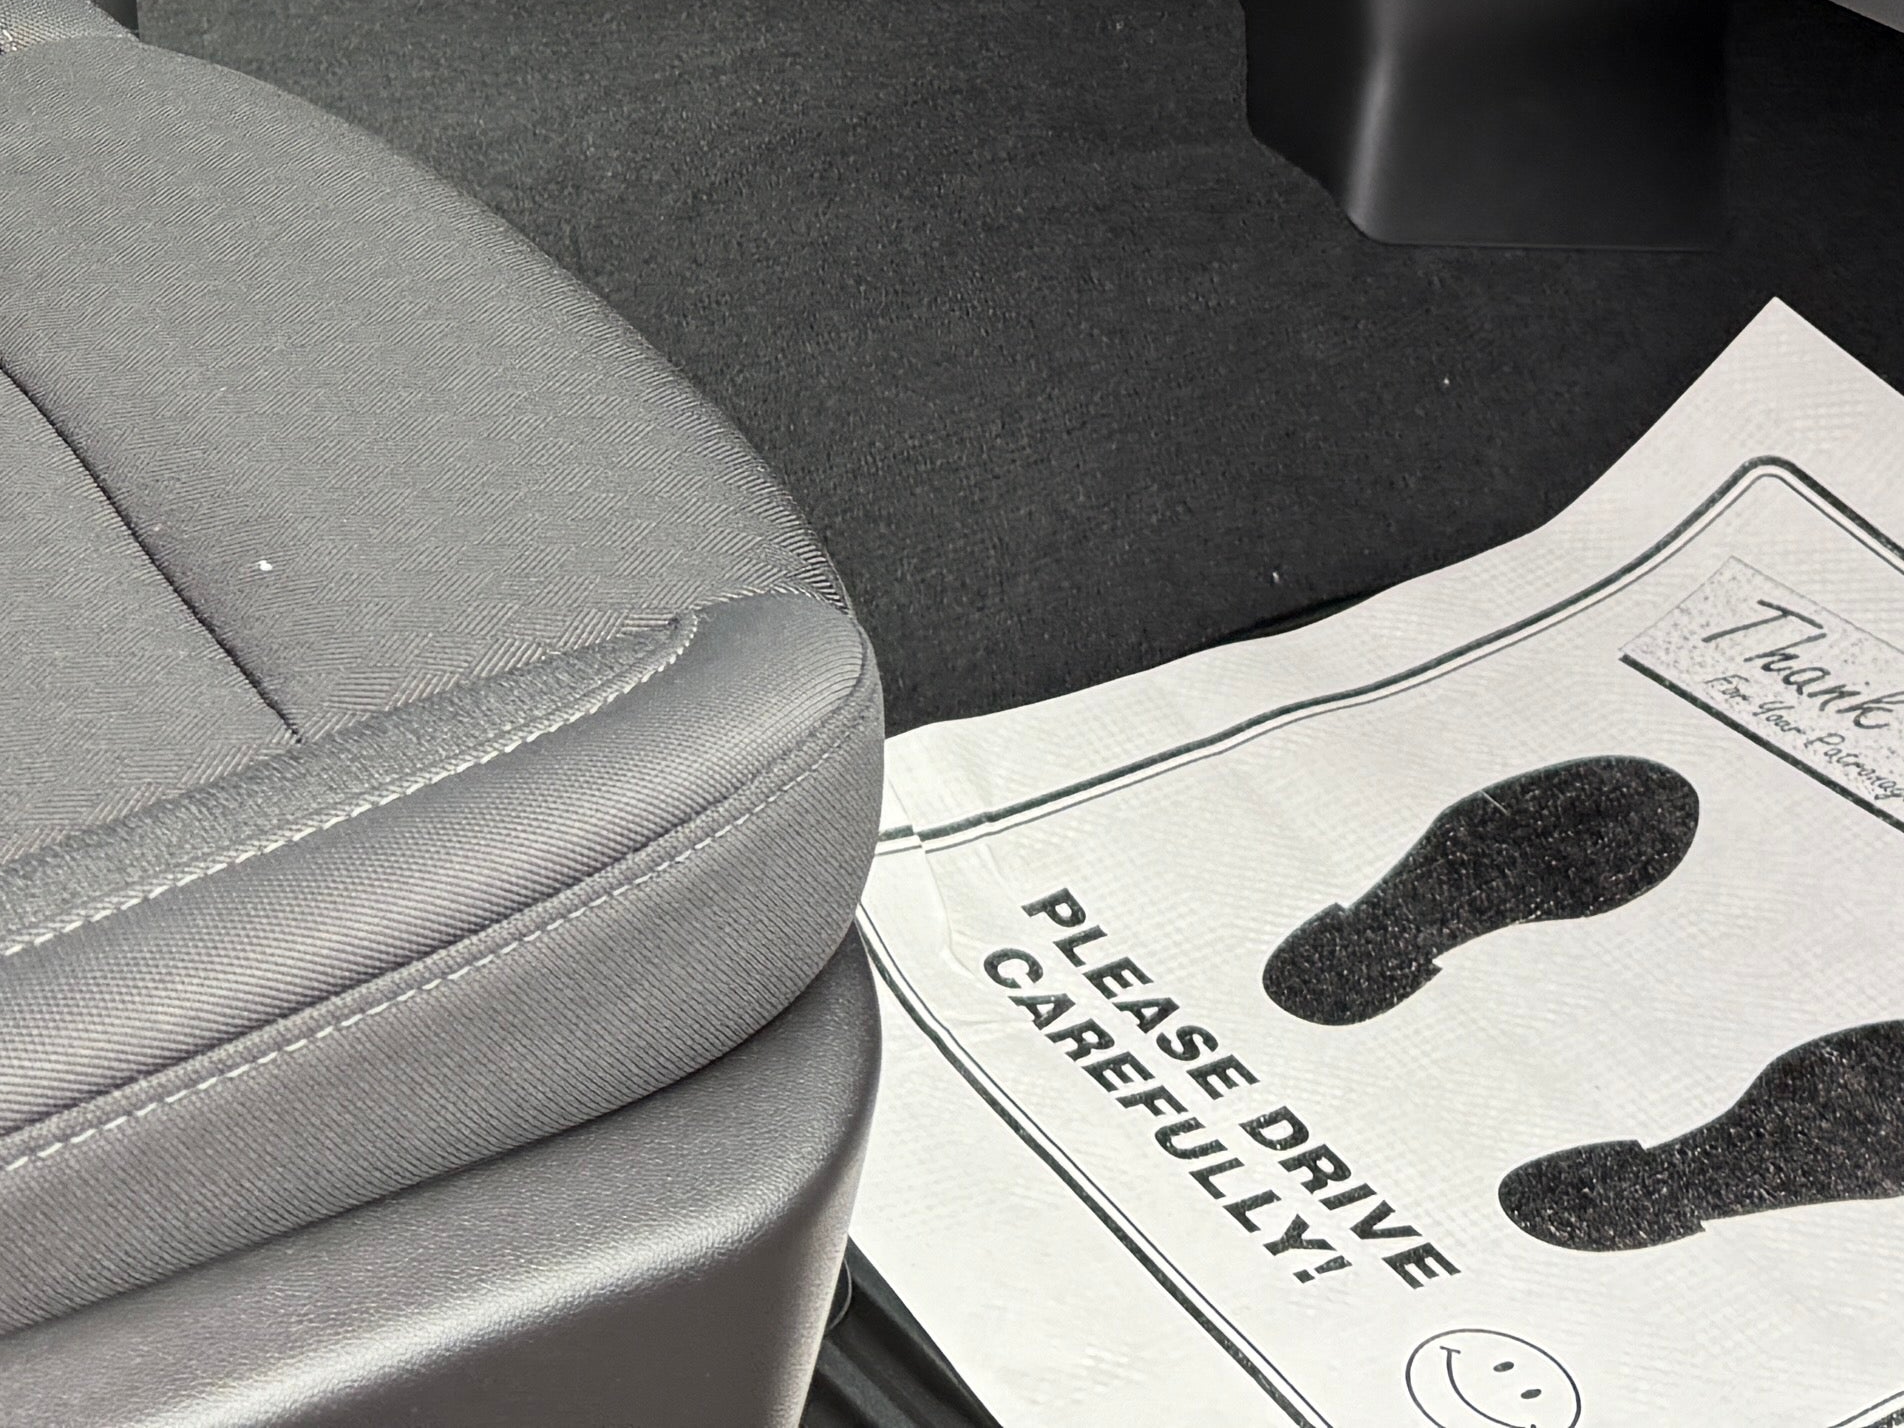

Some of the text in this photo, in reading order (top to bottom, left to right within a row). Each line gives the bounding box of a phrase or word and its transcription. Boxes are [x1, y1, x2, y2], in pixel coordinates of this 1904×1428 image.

[1704, 673, 1750, 701] For
[983, 947, 1353, 1284] CAREFULLY!
[1020, 887, 1461, 1289] PLEASE DRIVE
